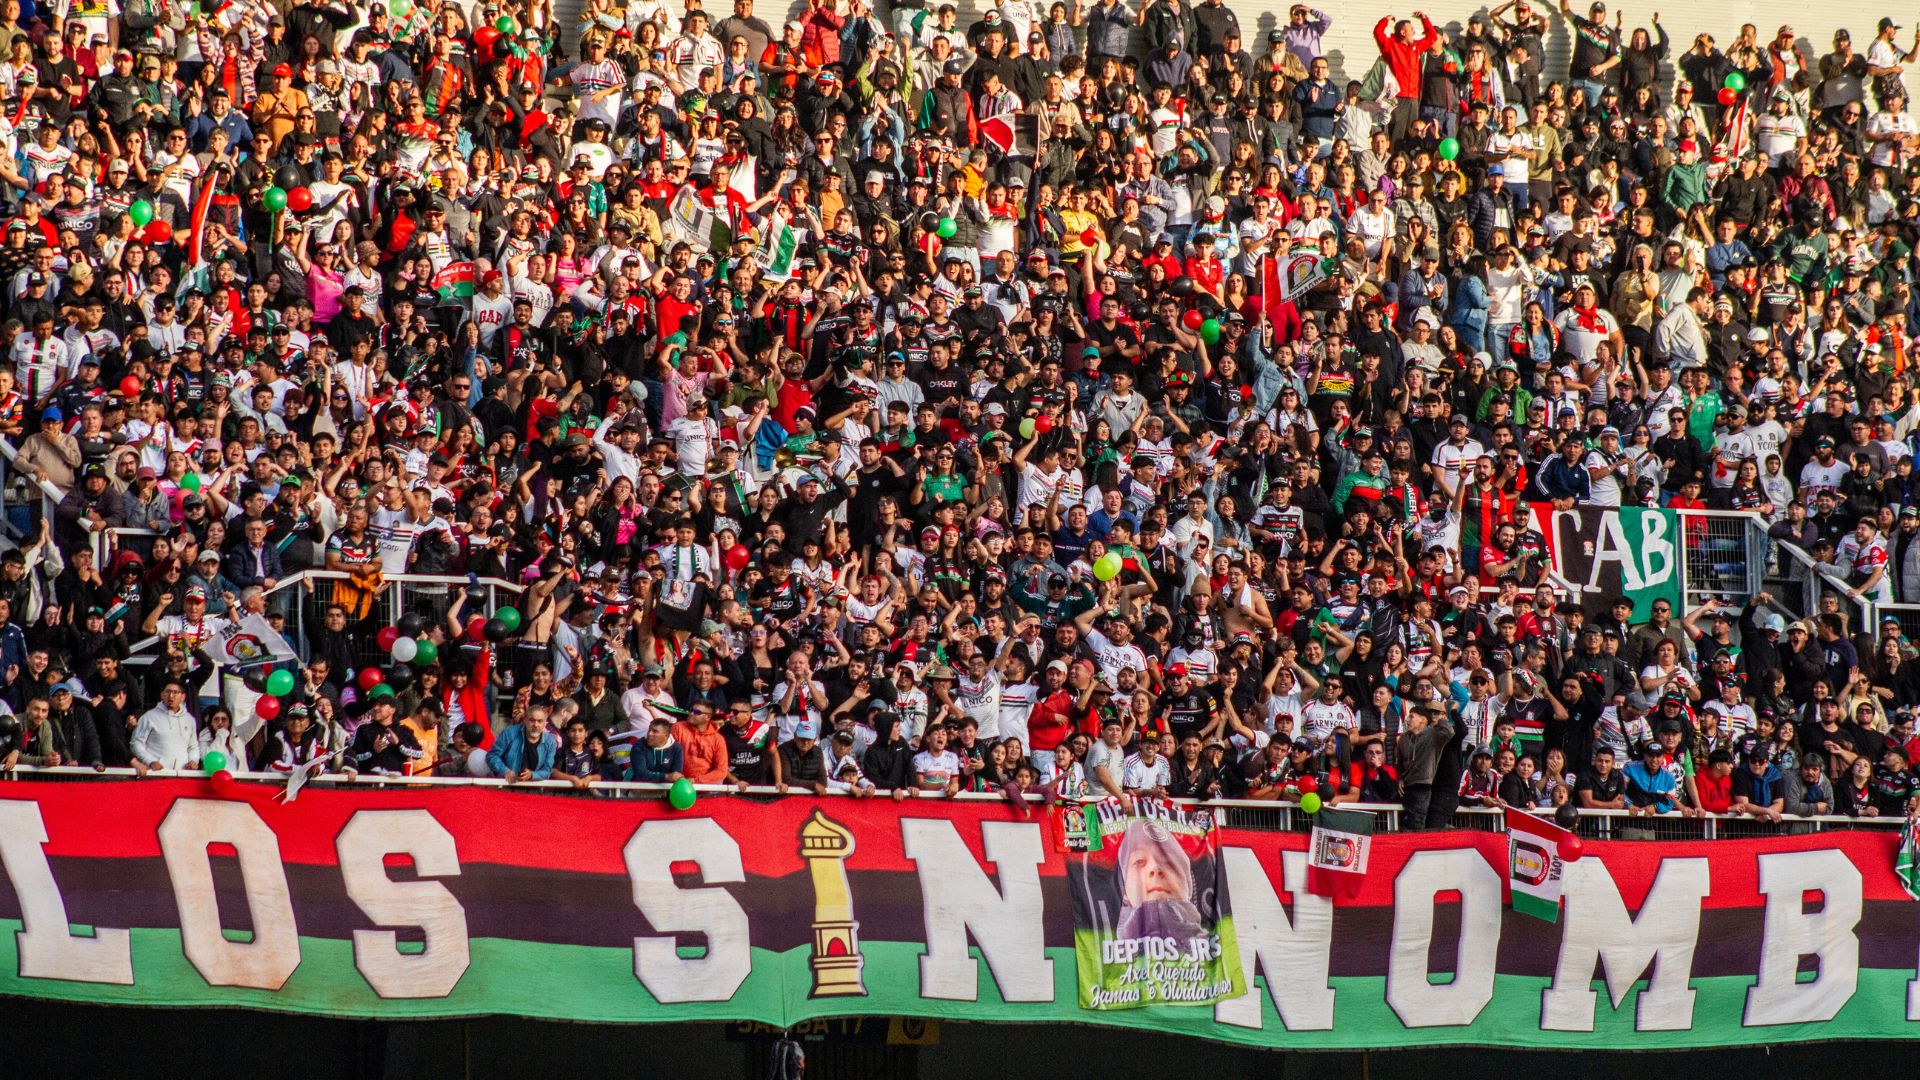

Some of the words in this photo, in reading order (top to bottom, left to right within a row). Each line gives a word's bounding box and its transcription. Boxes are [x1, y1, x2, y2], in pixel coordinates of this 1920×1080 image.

[58, 219, 93, 231] UNICO
[479, 310, 502, 325] GAP
[929, 380, 958, 389] OAKLEY
[1322, 379, 1350, 391] CRISTAL
[964, 695, 993, 709] UNICO
[1548, 855, 1562, 881] LOTA
[0, 797, 471, 998] LOS
[1213, 844, 1920, 1031] NOMB
[1102, 936, 1179, 964] DEPTOS
[1184, 934, 1222, 963] JRS
[1120, 963, 1150, 986] Axel
[1152, 961, 1206, 982] Querido
[1089, 984, 1140, 1008] Jamas
